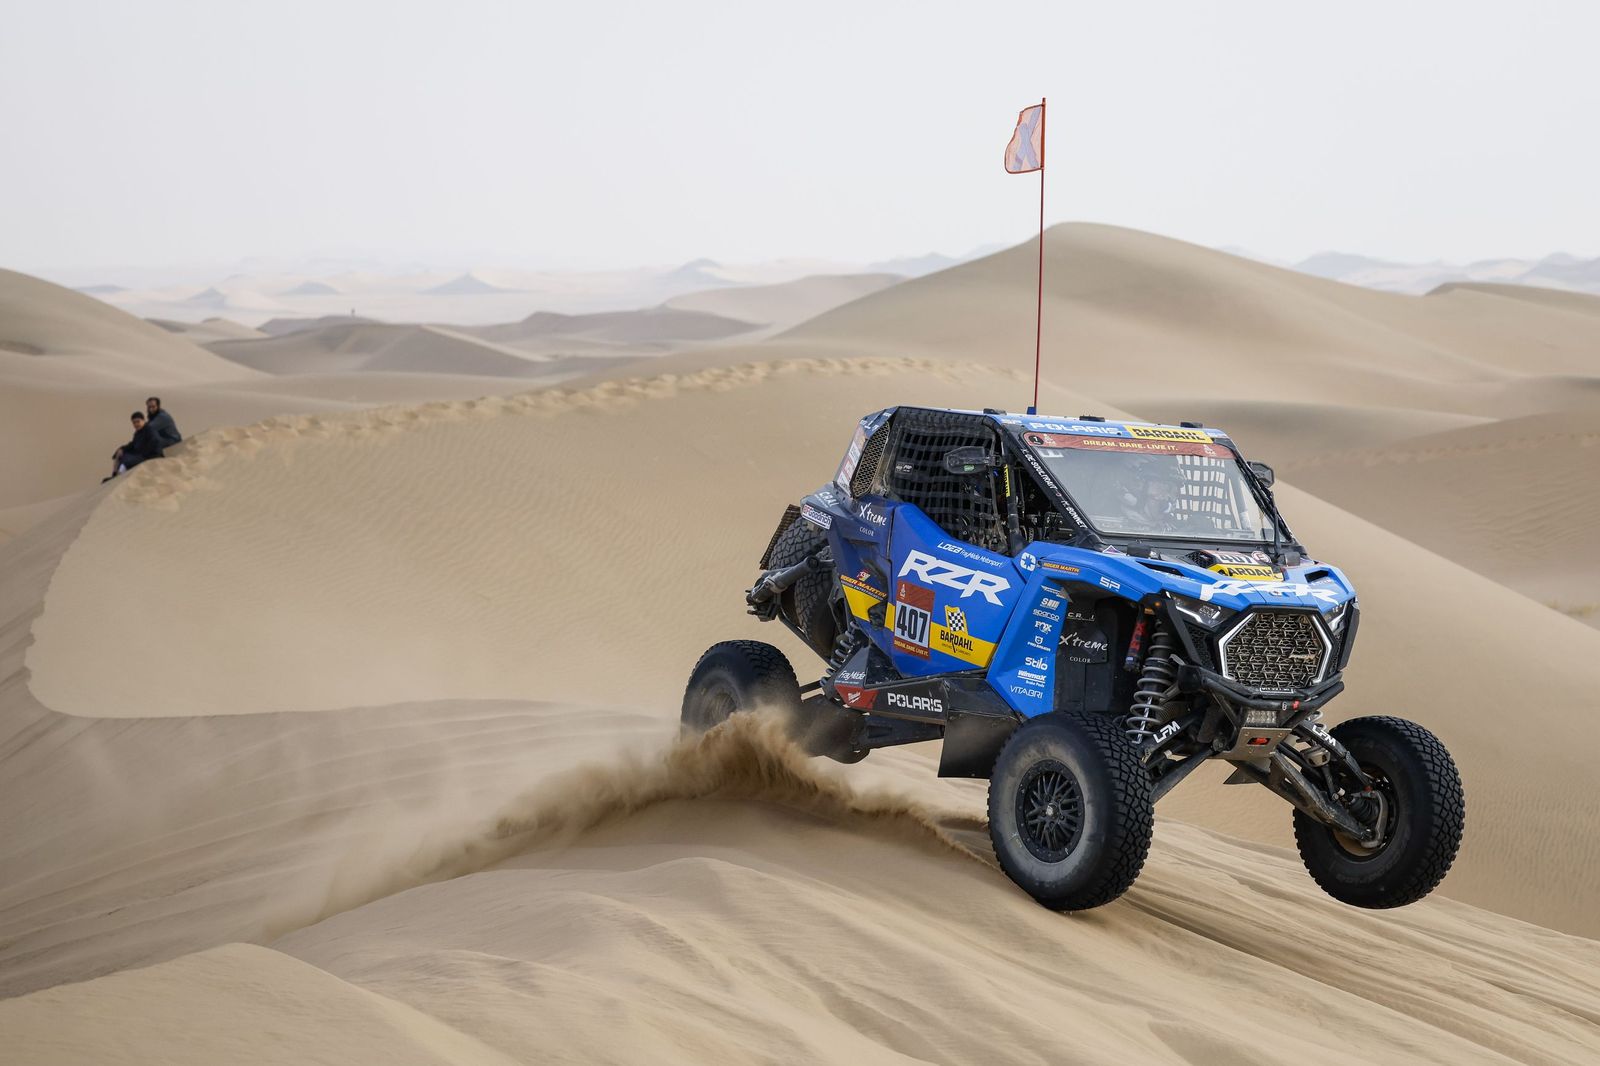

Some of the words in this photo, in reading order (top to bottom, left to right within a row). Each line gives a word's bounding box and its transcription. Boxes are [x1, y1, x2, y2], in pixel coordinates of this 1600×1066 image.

[1029, 422, 1122, 435] POLARIS
[1132, 428, 1206, 441] BARDAHL
[1082, 439, 1118, 447] DREAM.
[859, 526, 874, 537] COLOR
[937, 541, 963, 554] LOEB
[1060, 564, 1079, 573] MARTIN
[898, 549, 1011, 607] RZR
[857, 582, 887, 598] MARTIN
[896, 604, 928, 643] 407
[1034, 620, 1053, 633] FOX
[940, 630, 974, 652] BARDAHL
[1024, 656, 1048, 671] Stilo
[1069, 656, 1091, 664] COLOR
[1010, 685, 1044, 699] VITABRI
[887, 692, 943, 713] POLARIS
